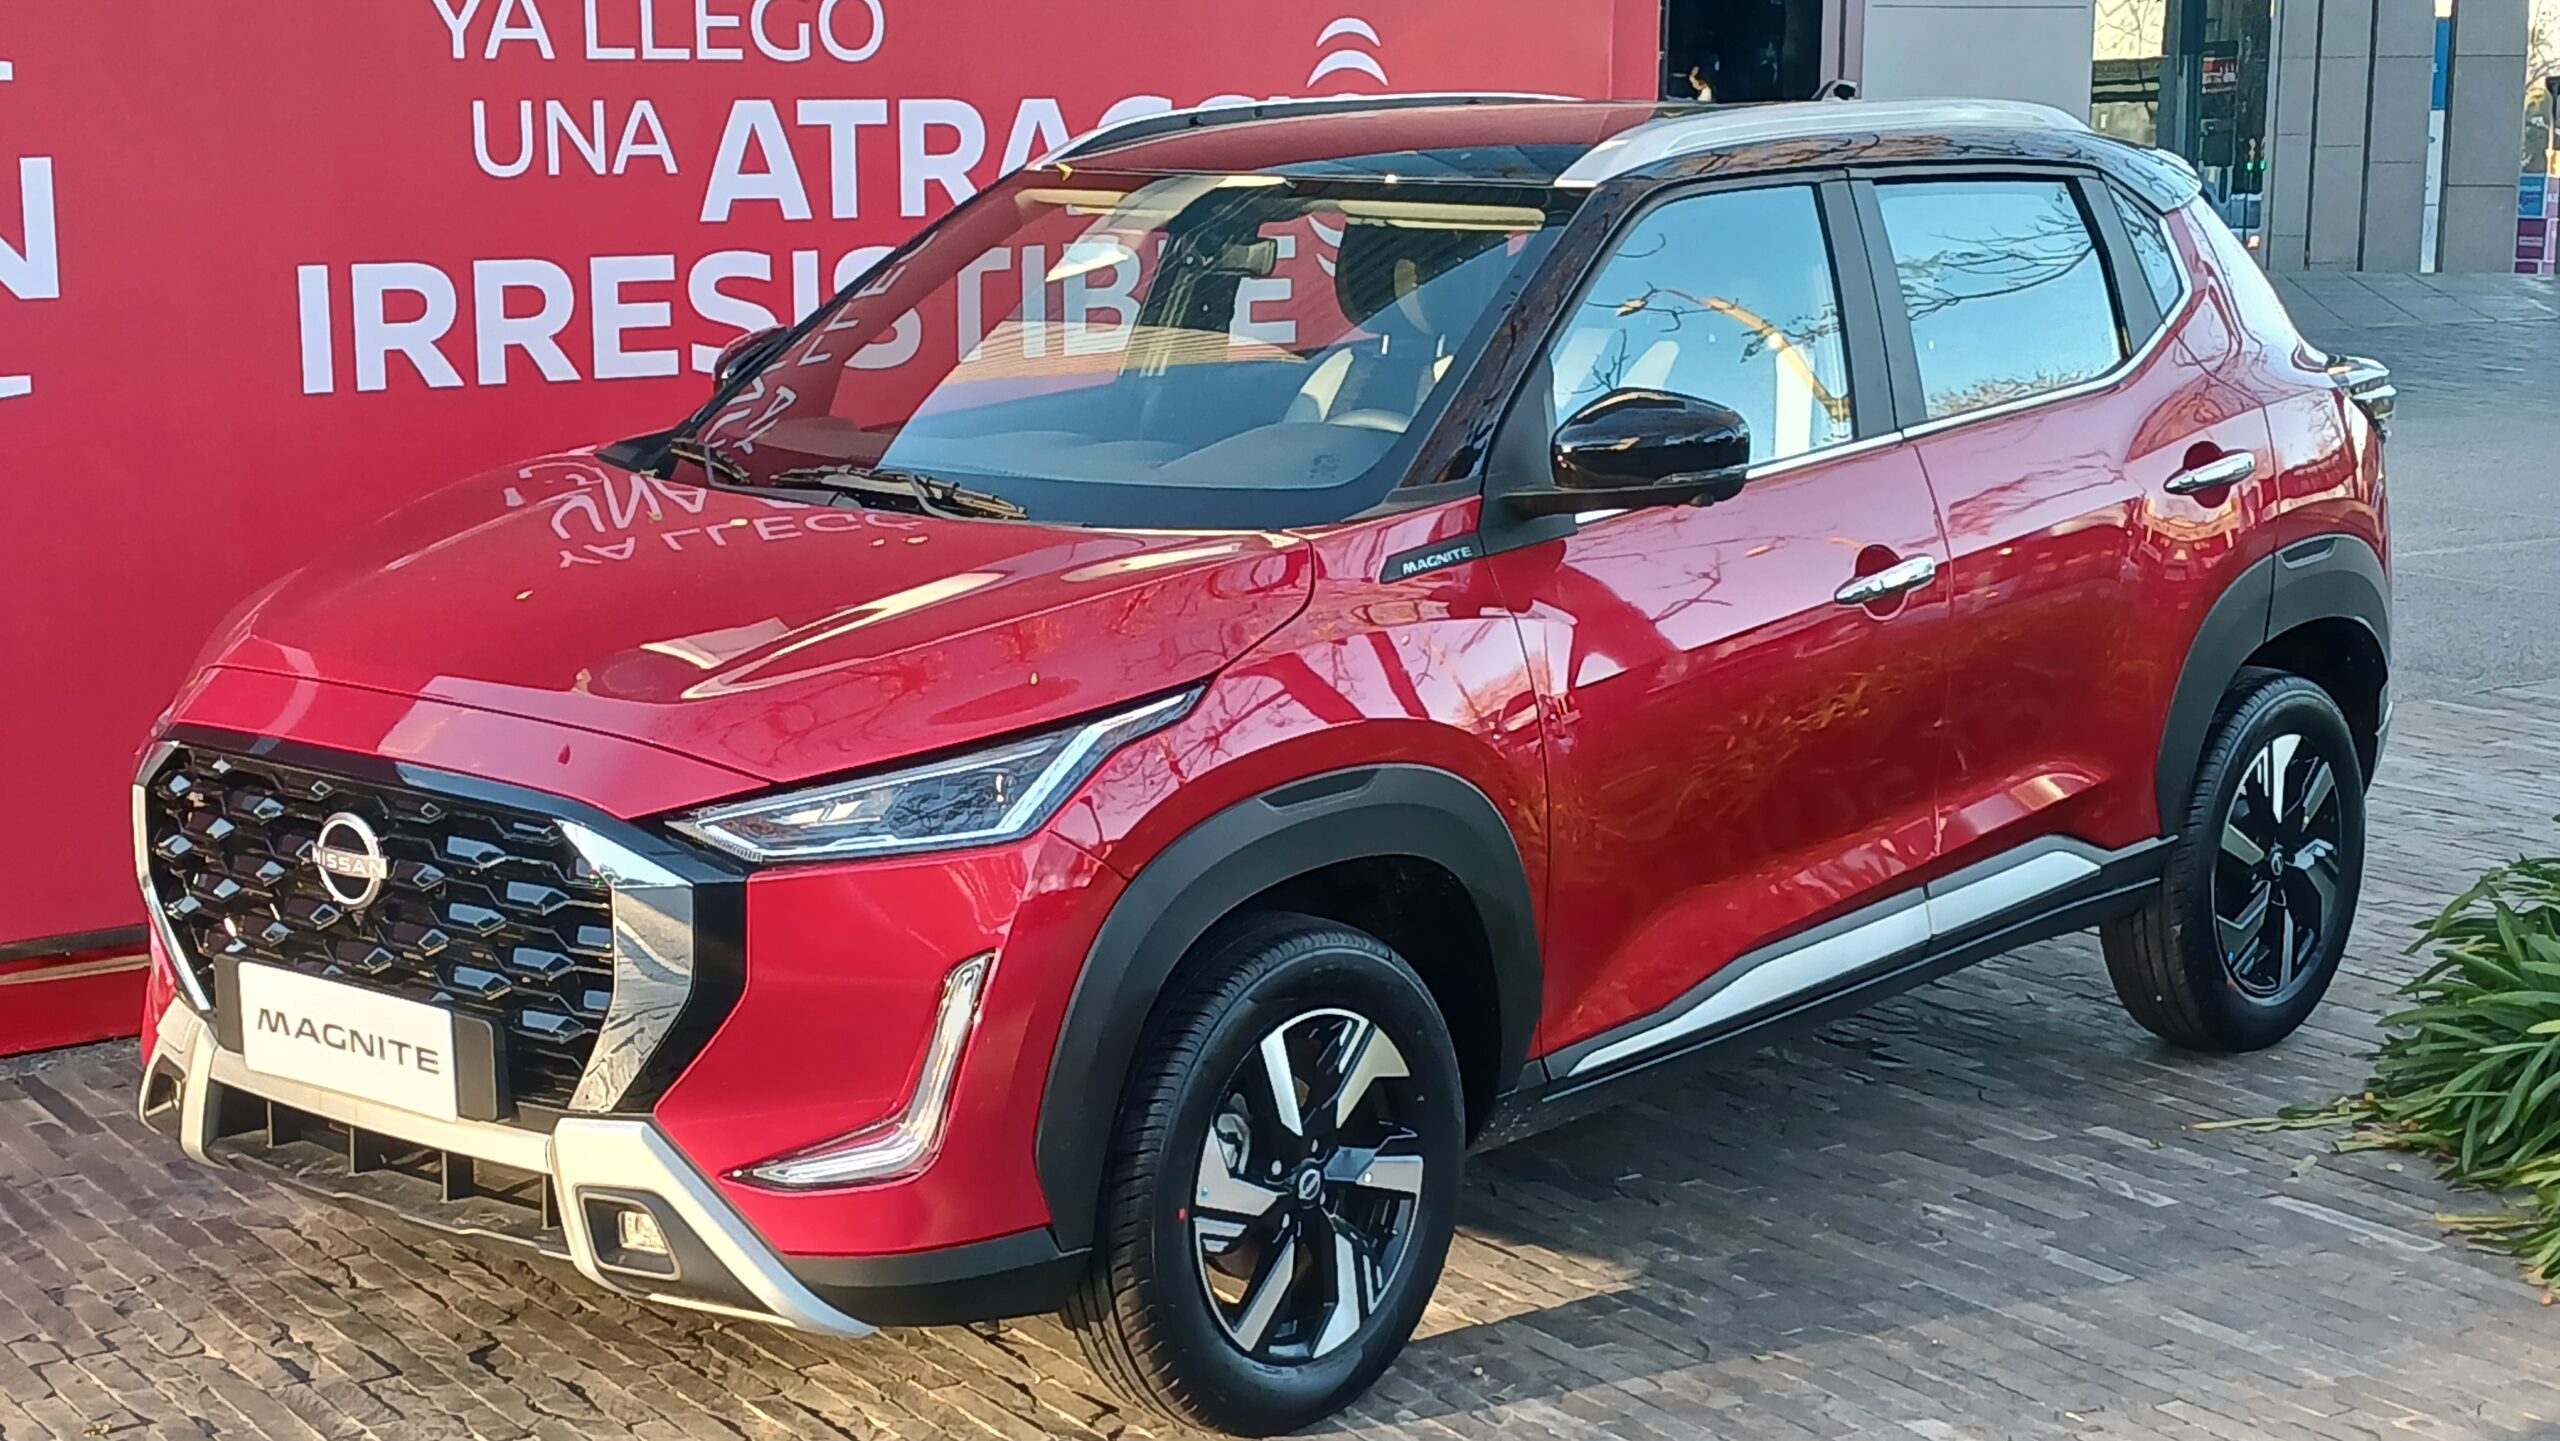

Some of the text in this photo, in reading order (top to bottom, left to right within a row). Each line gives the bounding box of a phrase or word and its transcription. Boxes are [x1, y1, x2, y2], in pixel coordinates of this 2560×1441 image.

[431, 0, 885, 62] YA LLEGO
[472, 92, 1362, 222] UNA ATRA
[297, 235, 1297, 395] IRRESISTIBE
[1402, 546, 1473, 575] MAGNITE
[312, 847, 387, 879] NISSAN
[257, 1007, 441, 1076] MAGNITE
